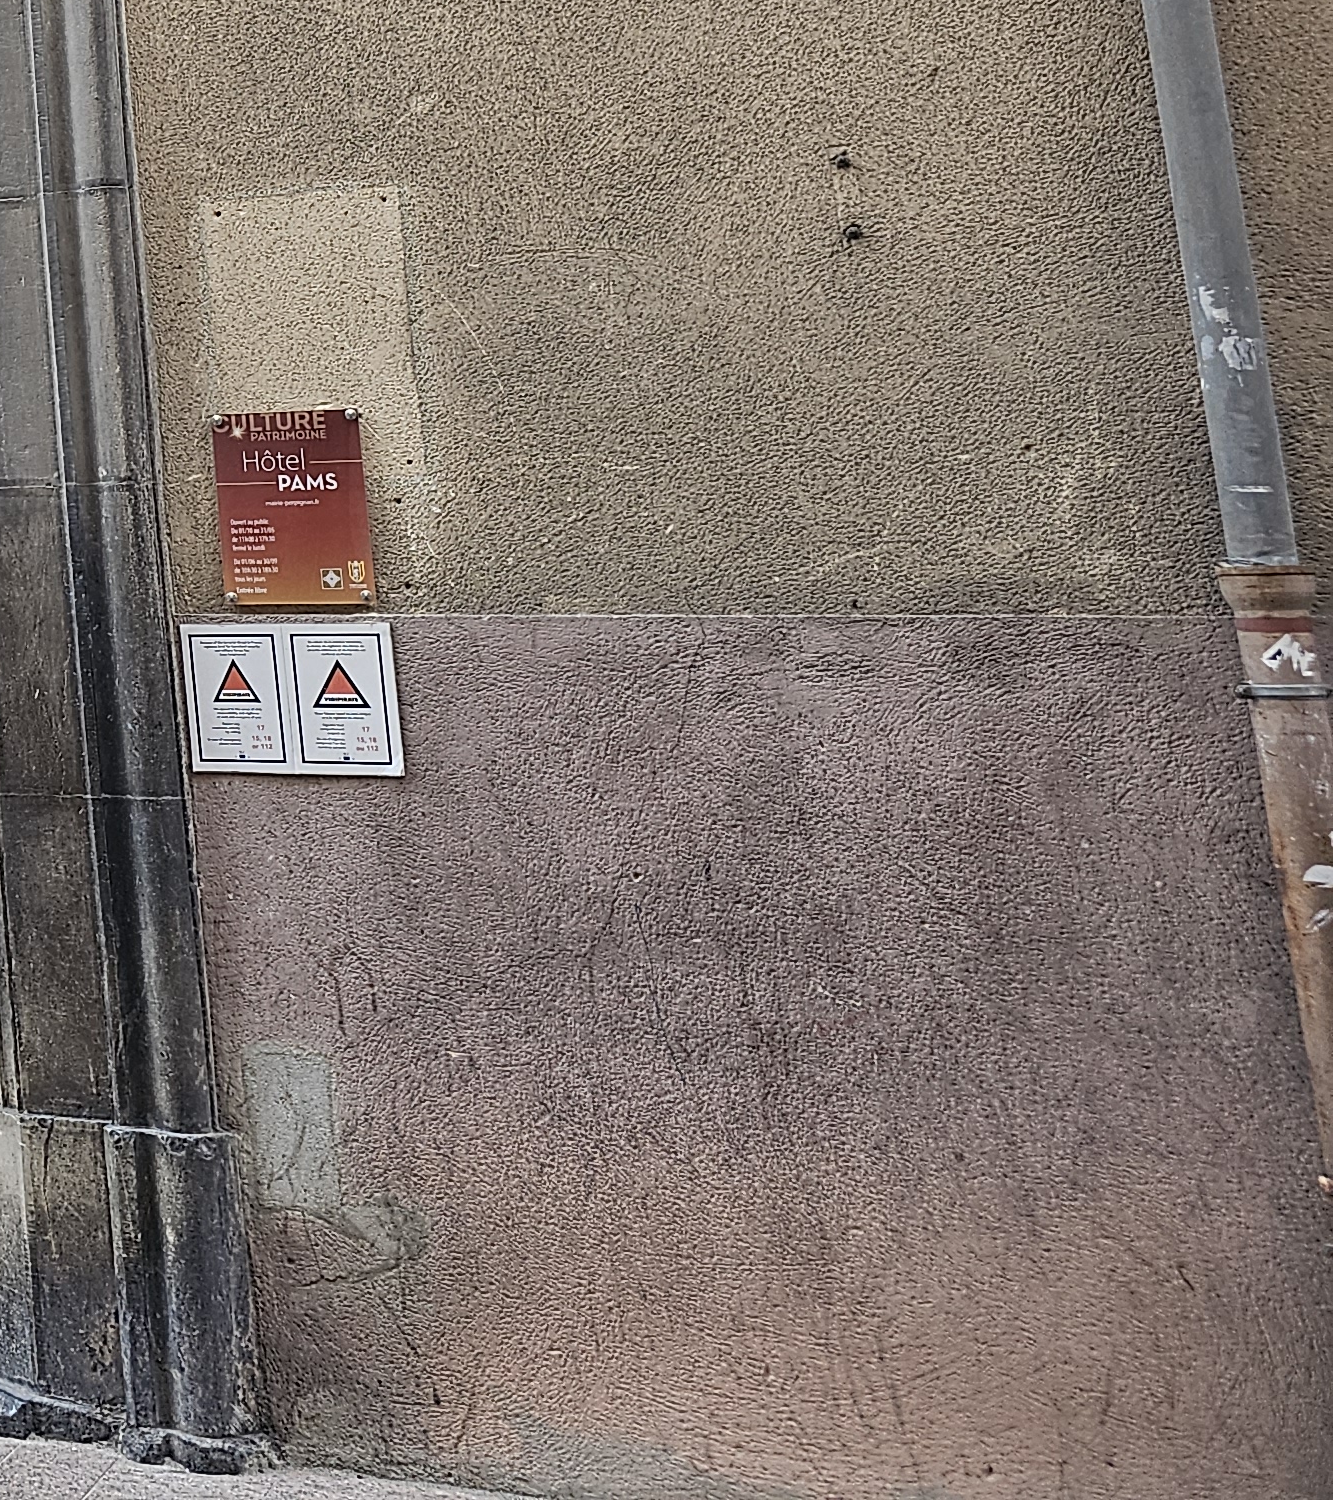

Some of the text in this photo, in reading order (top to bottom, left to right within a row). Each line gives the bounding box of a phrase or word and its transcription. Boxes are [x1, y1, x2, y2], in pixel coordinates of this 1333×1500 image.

[213, 411, 326, 433] CULTURE
[250, 429, 327, 441] PATRIMOINE
[242, 447, 306, 472] Hôtel
[277, 472, 338, 492] PAMS
